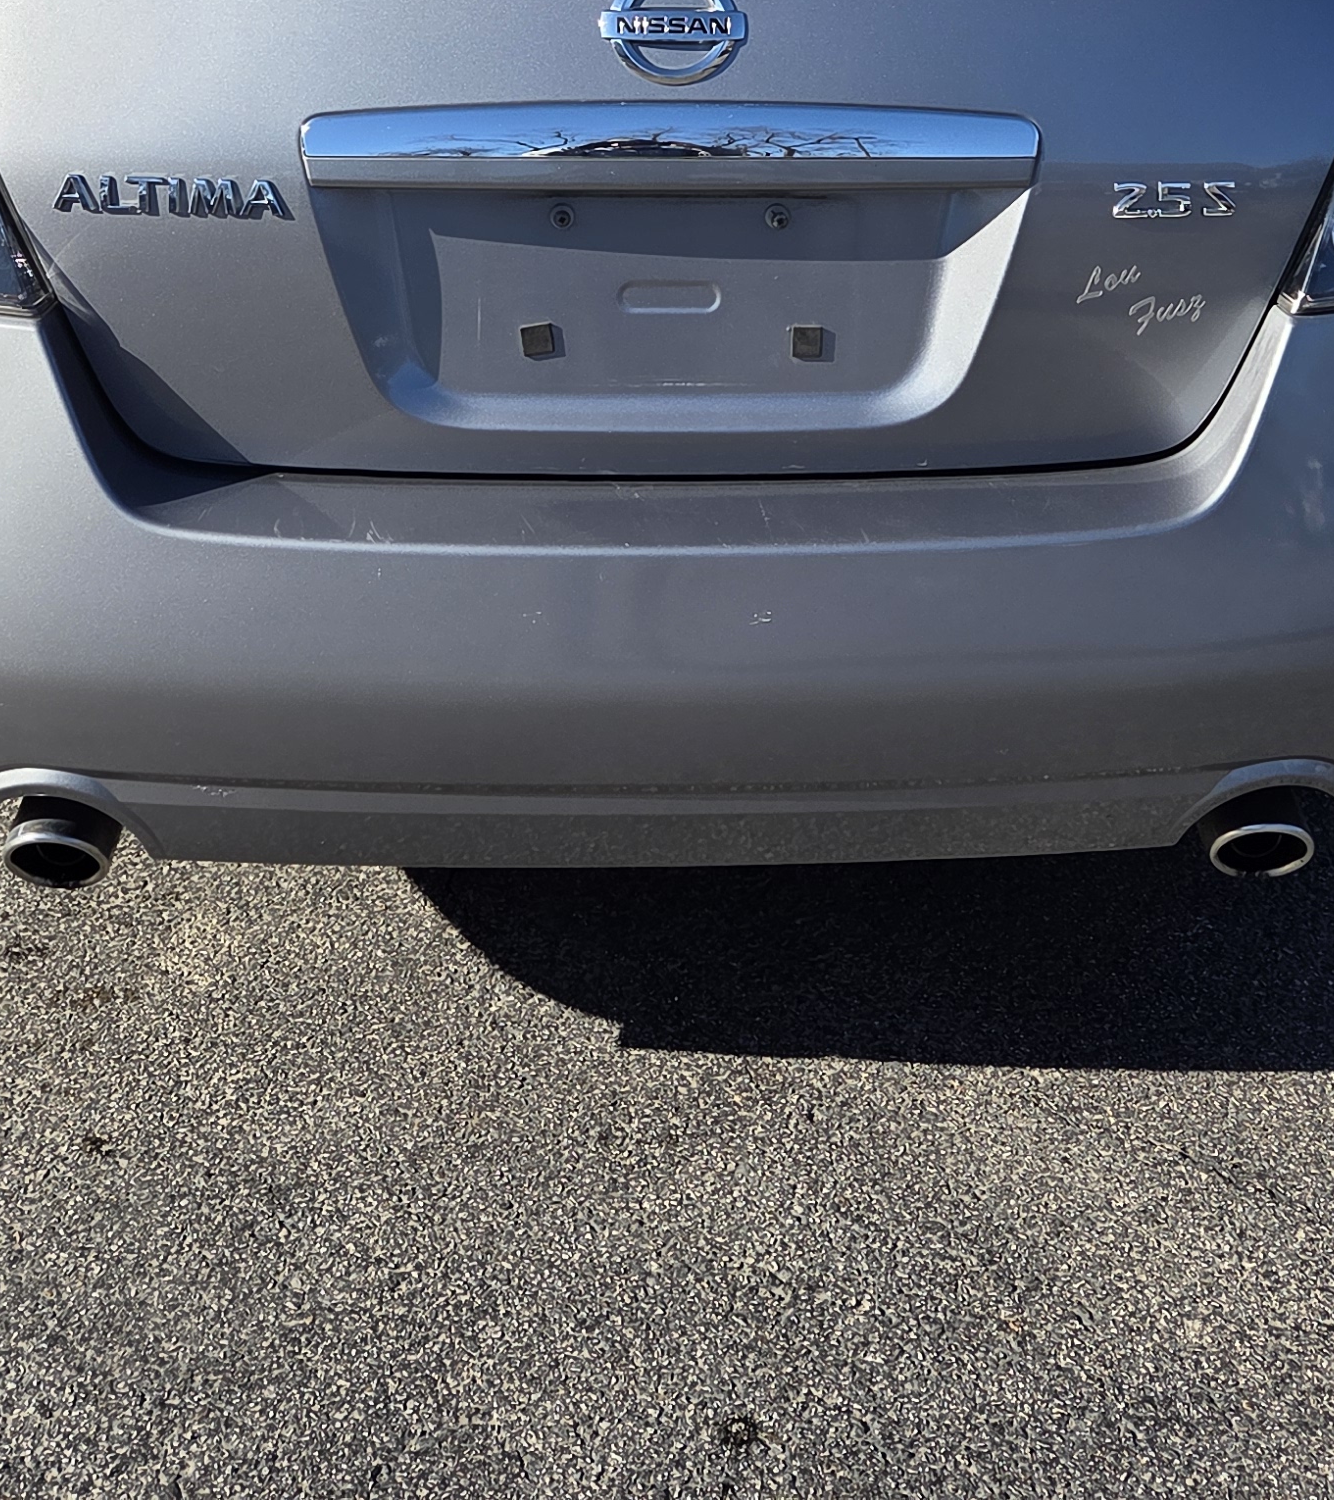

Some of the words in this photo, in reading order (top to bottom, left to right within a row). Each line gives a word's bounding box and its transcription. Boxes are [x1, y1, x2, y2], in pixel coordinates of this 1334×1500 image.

[616, 16, 732, 35] NISSAN
[52, 173, 293, 220] ALTIMA
[1112, 181, 1192, 218] 2.5
[1202, 181, 1236, 217] S
[1076, 265, 1141, 304] Lou
